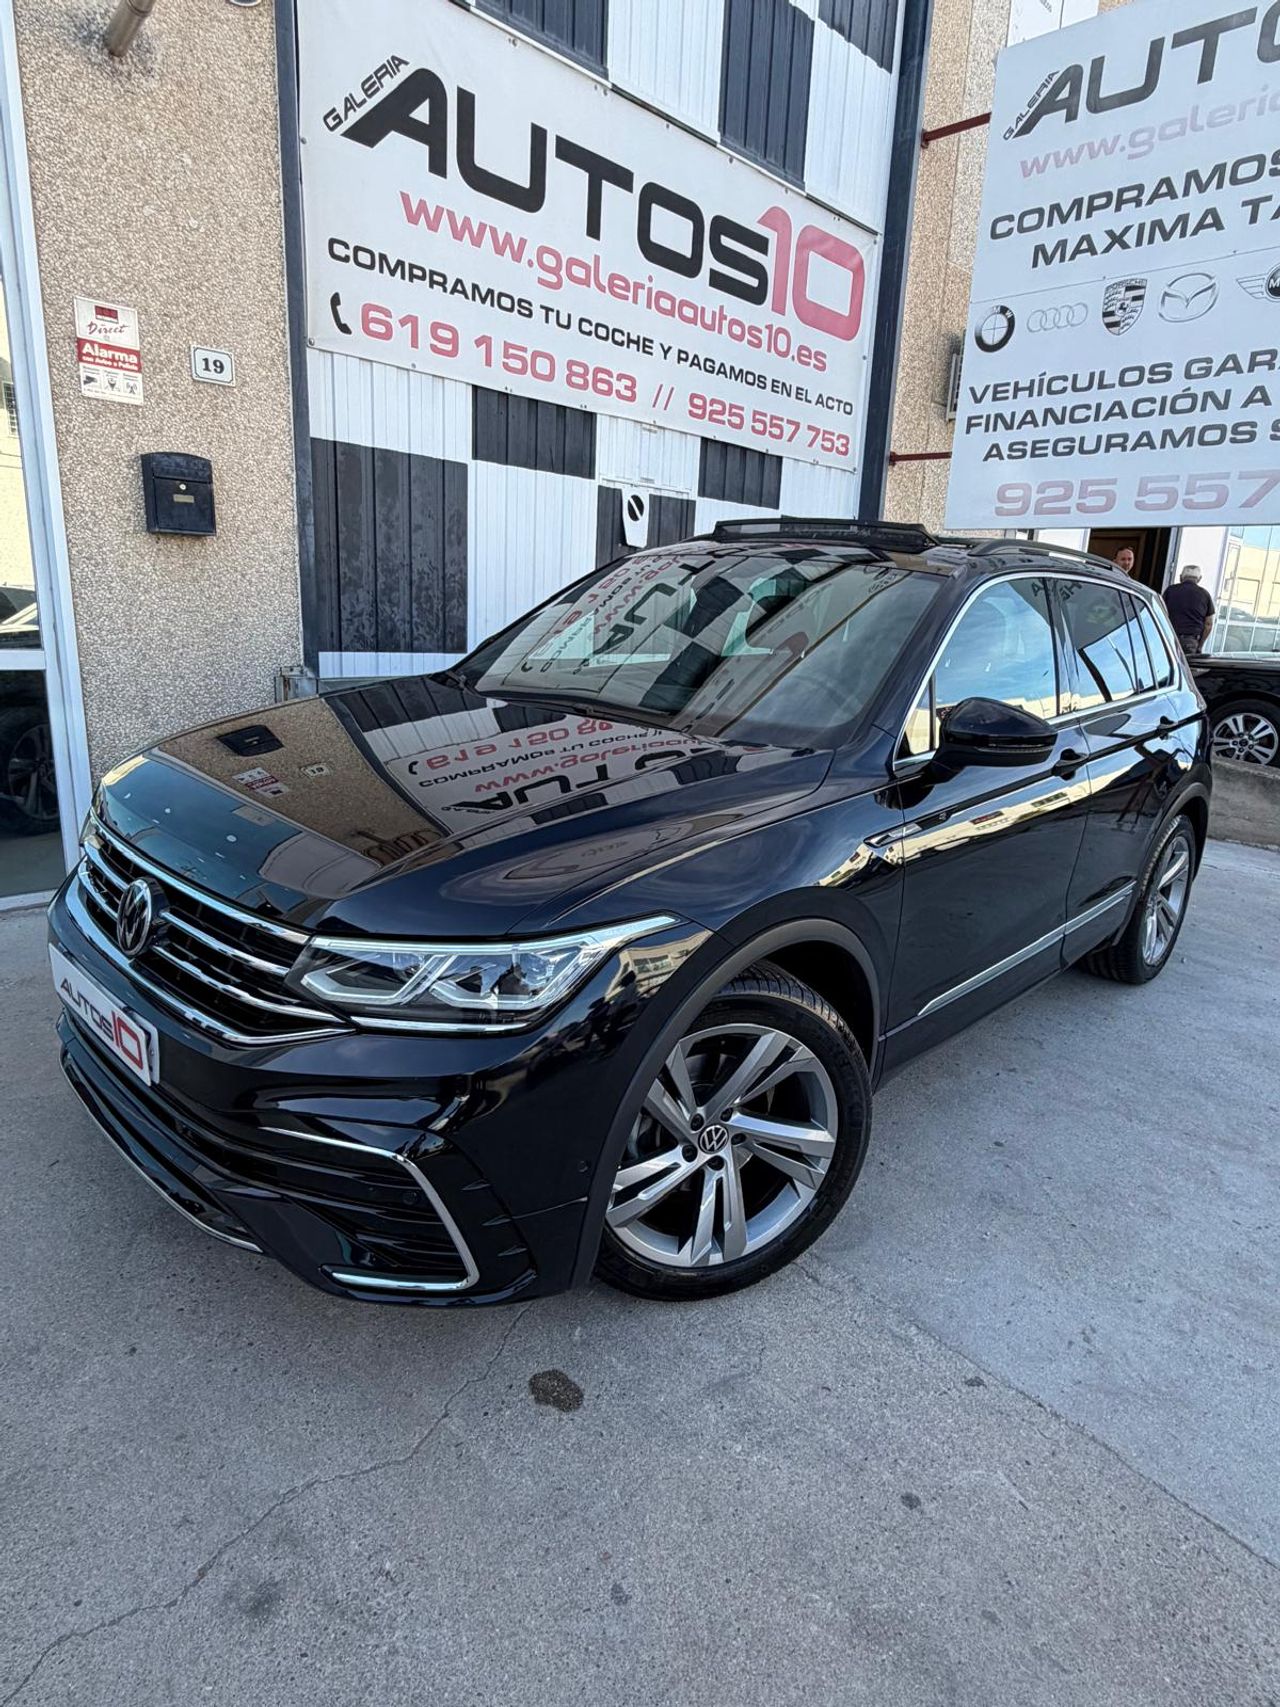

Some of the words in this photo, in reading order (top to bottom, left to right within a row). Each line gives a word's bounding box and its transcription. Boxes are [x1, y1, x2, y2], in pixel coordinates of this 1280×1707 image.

[322, 55, 410, 132] GALERIA
[1012, 0, 1280, 139] AUT
[1003, 70, 1060, 141] GALERIA
[340, 67, 865, 341] AUTOS10
[1031, 207, 1225, 269] MAXIMA
[1241, 194, 1280, 225] T
[400, 190, 827, 372] www.galeriaautos10.es
[82, 342, 138, 364] Alarma
[328, 237, 533, 319] COMPRAMOS
[540, 304, 572, 330] TU
[578, 317, 654, 357] COCHE
[659, 342, 672, 360] Y
[677, 349, 767, 390] PAGAMOS
[771, 379, 793, 398] EN
[795, 387, 812, 404] EL
[815, 393, 853, 416] ACTO
[202, 357, 225, 375] 19
[361, 302, 459, 358] 619
[473, 334, 556, 382] 150
[565, 359, 637, 403] 863
[688, 392, 745, 430] 925
[751, 409, 801, 443] 557
[806, 424, 850, 456] 753
[969, 361, 1173, 404] VEHÍCULOS
[1184, 348, 1280, 380] GAR
[966, 387, 1232, 435] FINANCIACIÓN
[1240, 385, 1272, 409] A
[982, 421, 1257, 462] ASEGURAMOS
[995, 477, 1118, 517] 925
[1134, 468, 1280, 511] 557
[699, 1124, 729, 1154] VW
